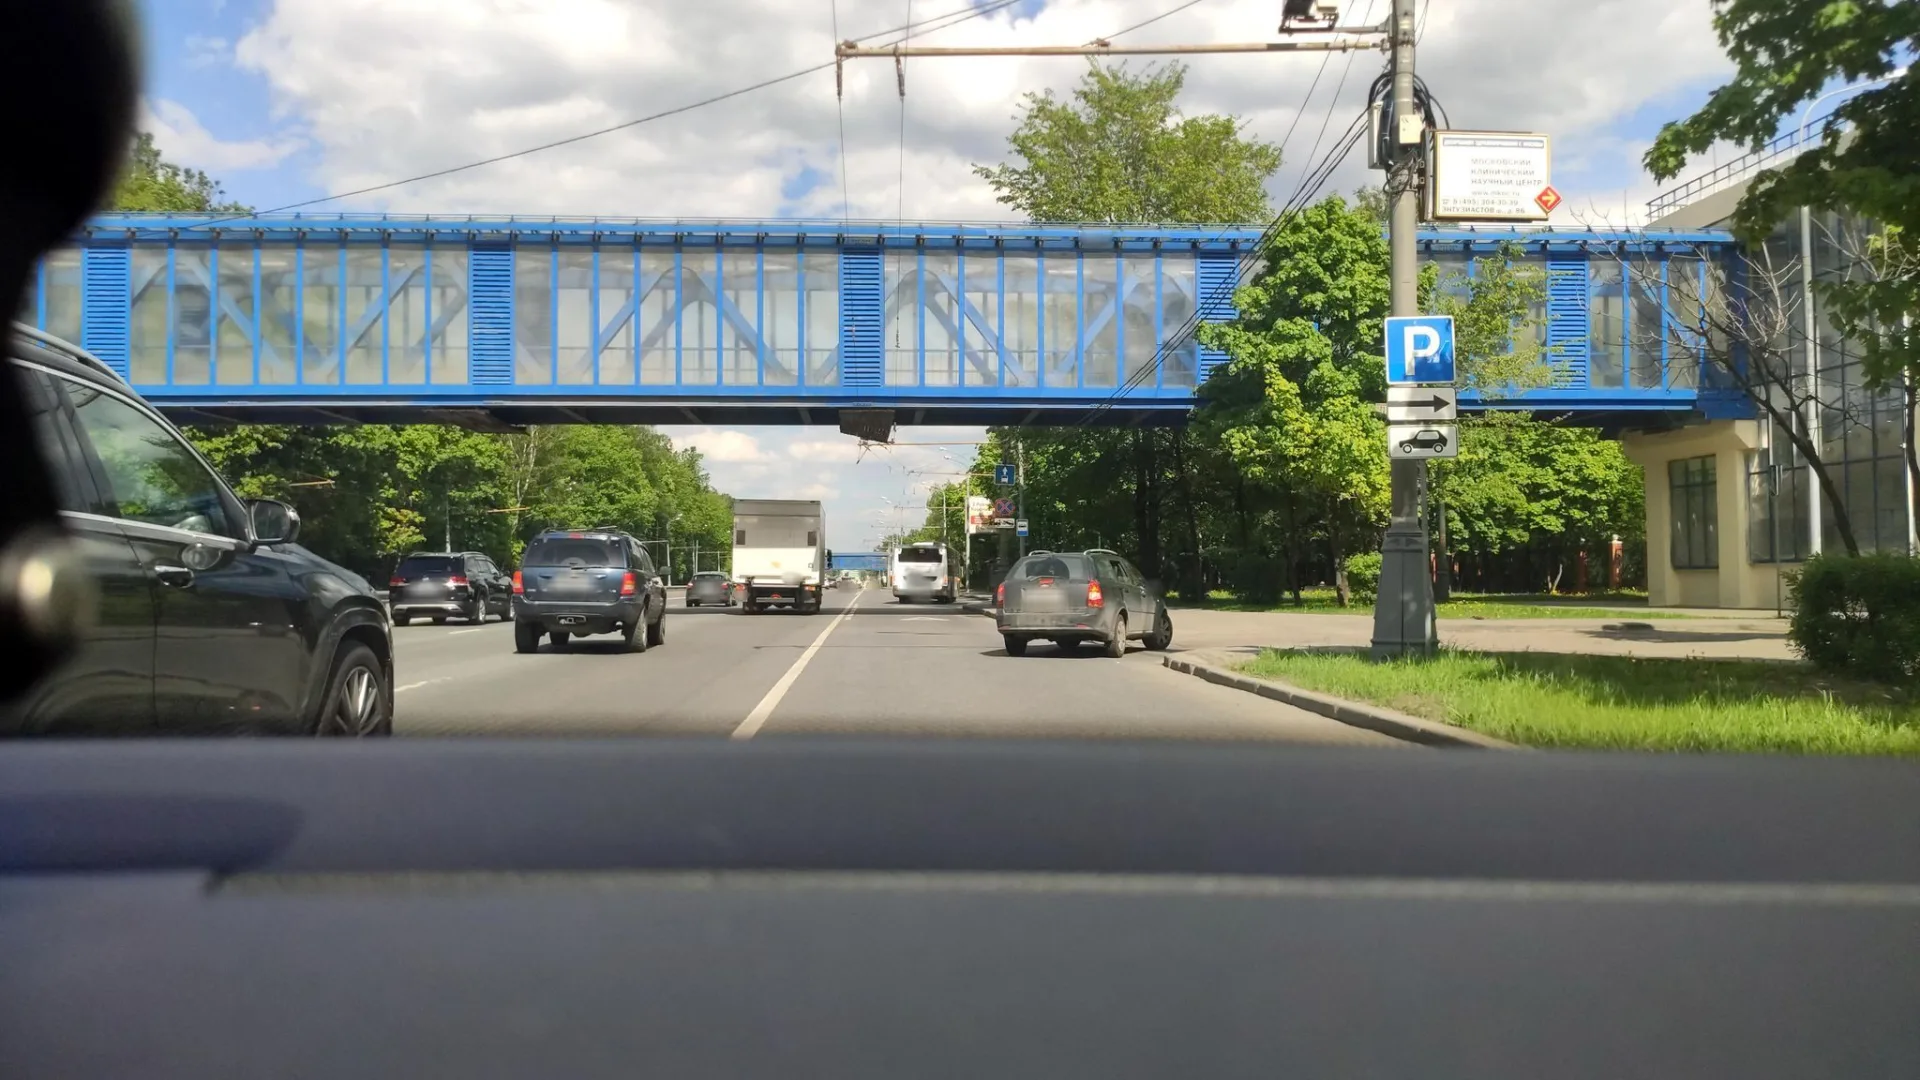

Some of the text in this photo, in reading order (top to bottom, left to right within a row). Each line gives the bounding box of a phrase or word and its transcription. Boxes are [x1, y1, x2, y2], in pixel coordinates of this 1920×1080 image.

[1471, 158, 1531, 166] МОСКОВСКИЙ
[1471, 168, 1535, 176] КЛИНИЧЕСКИЙ
[1404, 326, 1440, 376] P
